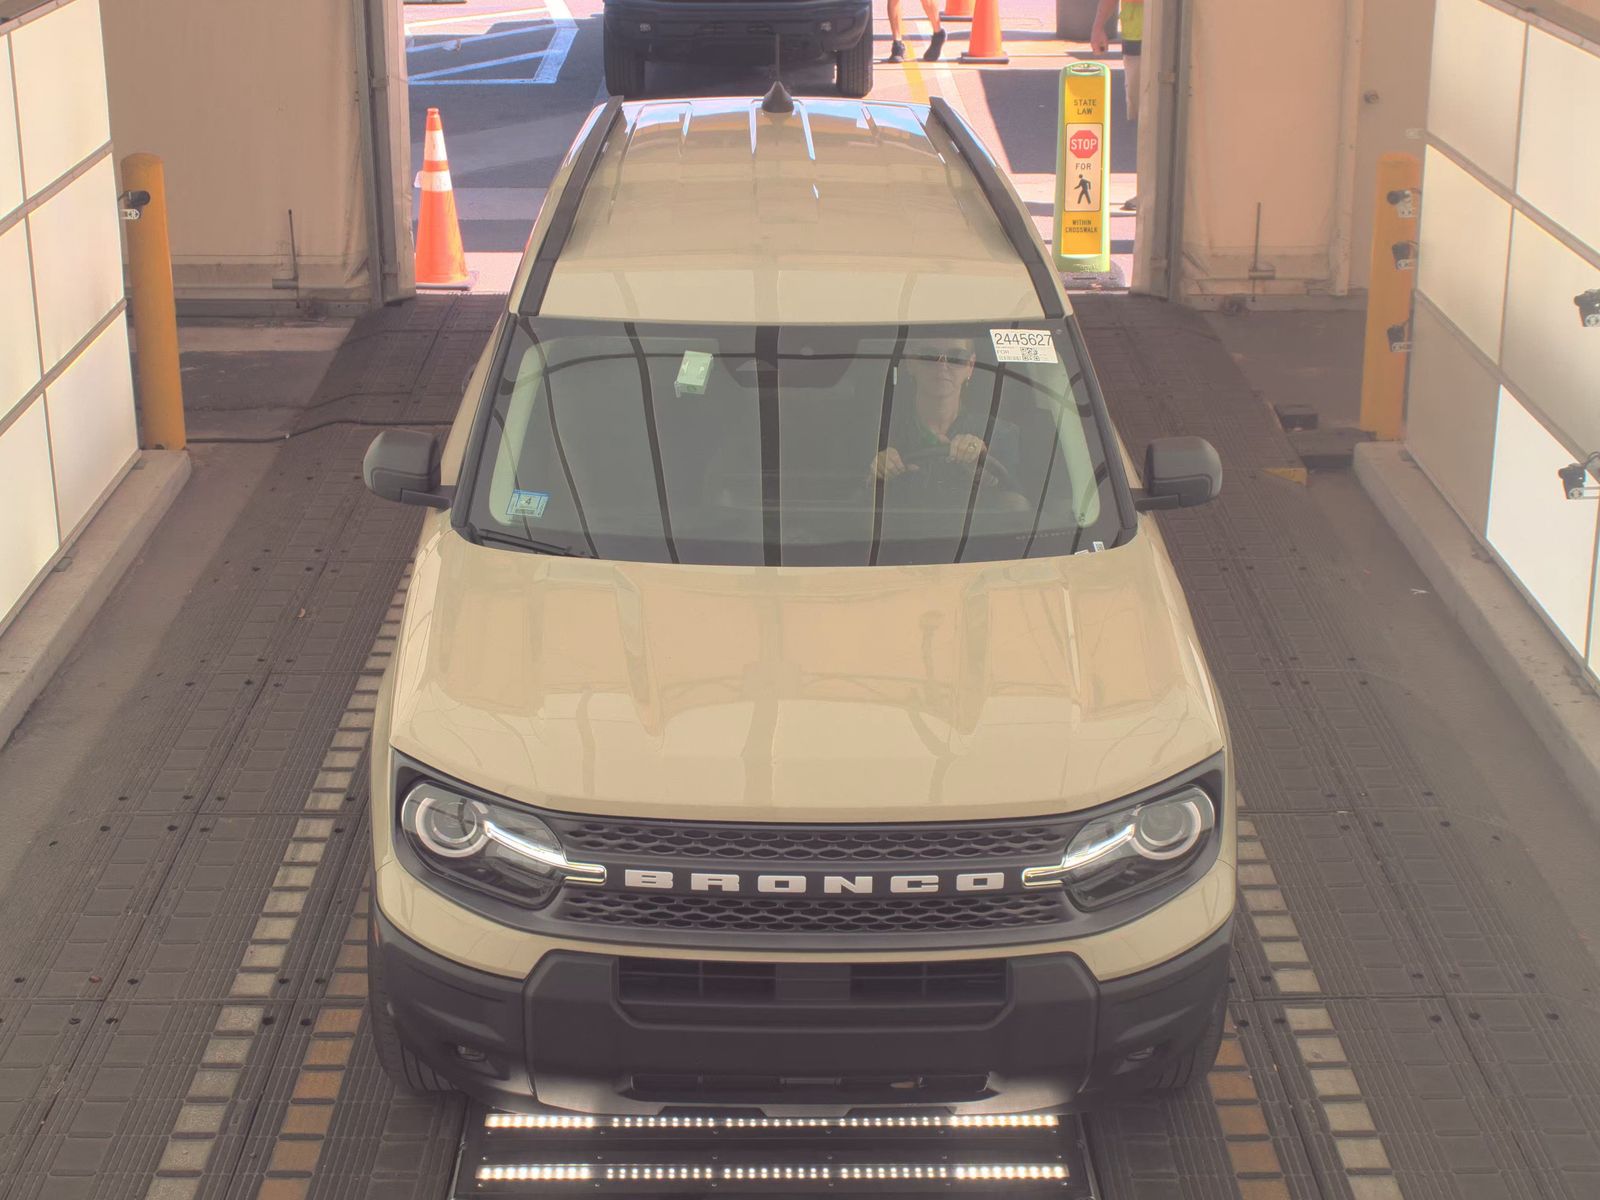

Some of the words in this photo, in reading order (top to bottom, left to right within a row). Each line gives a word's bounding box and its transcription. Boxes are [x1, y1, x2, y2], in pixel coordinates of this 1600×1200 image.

[1071, 139, 1097, 151] STOP
[994, 333, 1052, 346] 2445627
[625, 869, 1004, 894] BRONCO
